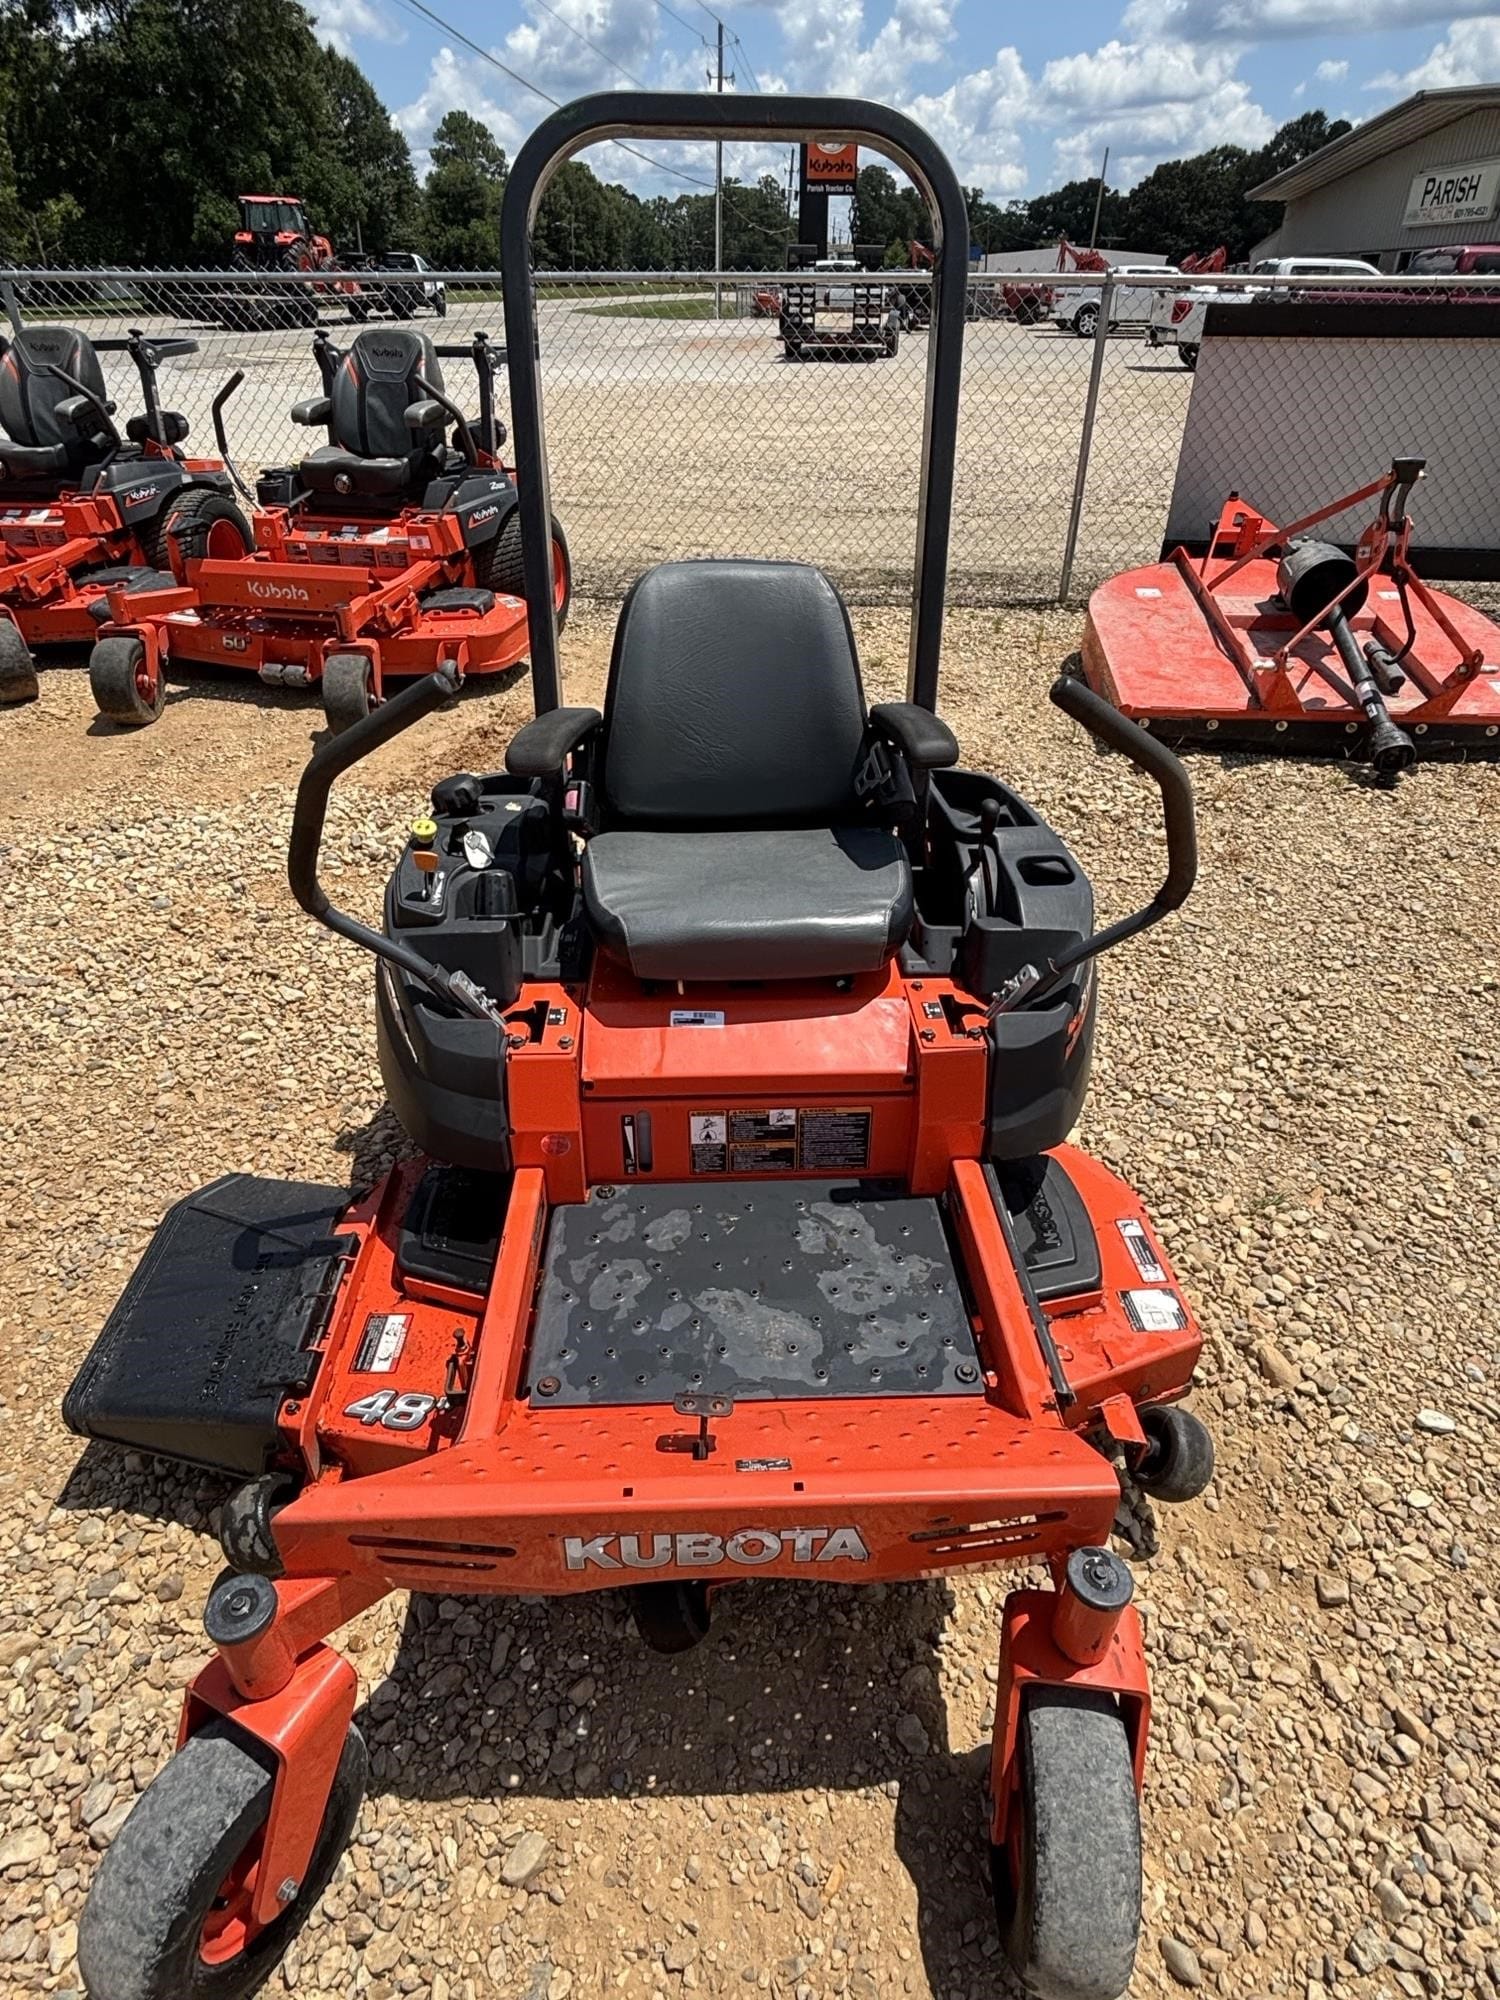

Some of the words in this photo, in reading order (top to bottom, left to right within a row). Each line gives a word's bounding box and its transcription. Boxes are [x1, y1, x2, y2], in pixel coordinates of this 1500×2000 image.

[809, 159, 853, 172] Kubota
[807, 184, 824, 192] Parish
[825, 184, 844, 192] Tractor
[1421, 174, 1481, 207] PARISH
[372, 347, 404, 358] Kubota
[472, 505, 499, 520] Kubota
[247, 580, 309, 601] Kubota
[562, 1526, 872, 1570] KUBOTA
